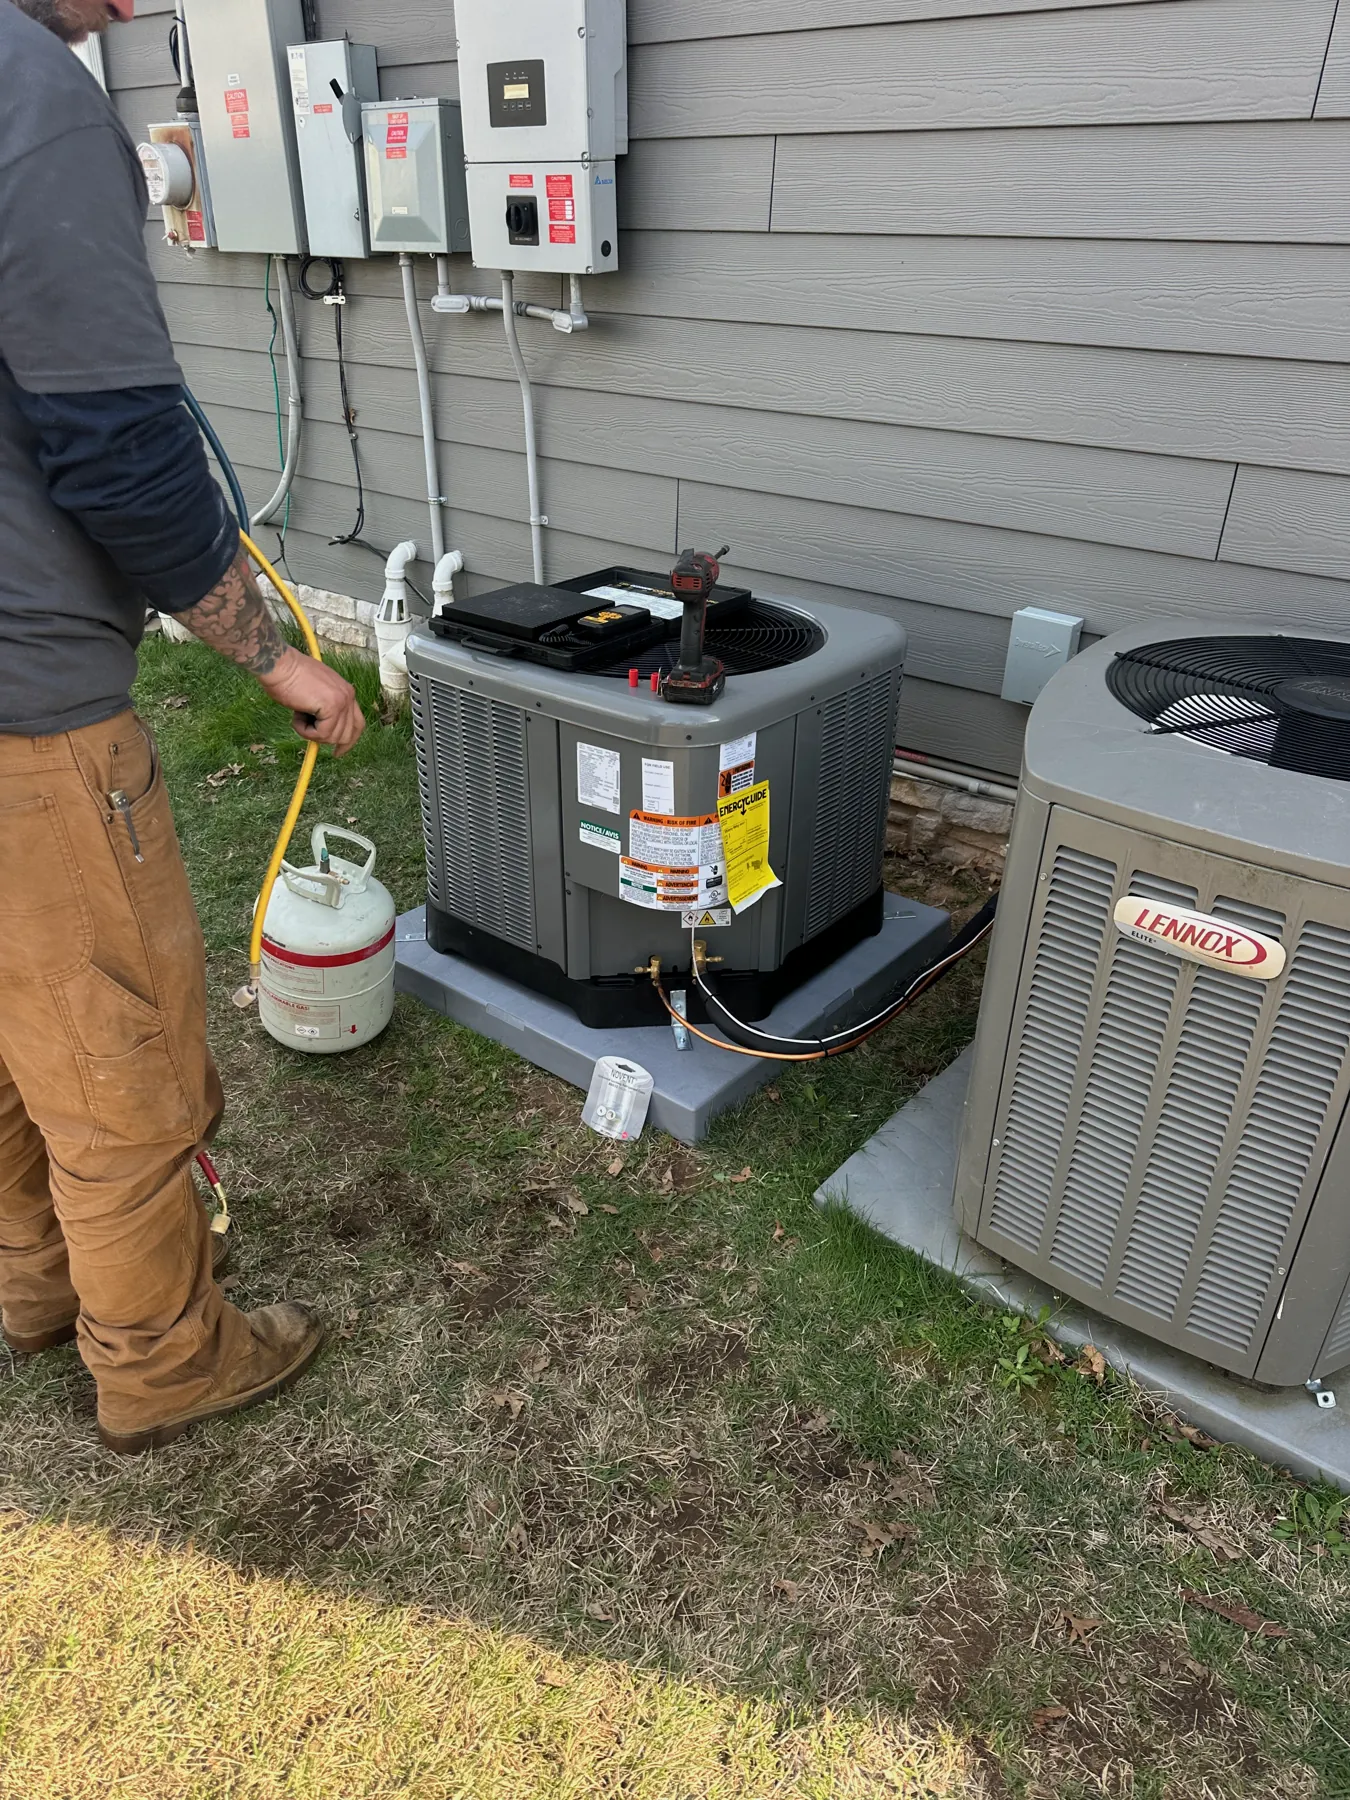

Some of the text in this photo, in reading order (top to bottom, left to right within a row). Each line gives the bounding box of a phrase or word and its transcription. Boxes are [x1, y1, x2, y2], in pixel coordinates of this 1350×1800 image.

[719, 788, 767, 816] ENERGYGUIDE
[580, 822, 619, 840] NOTICE/AVIS
[1134, 909, 1242, 958] LENNOX
[611, 1069, 635, 1085] NOVENT
